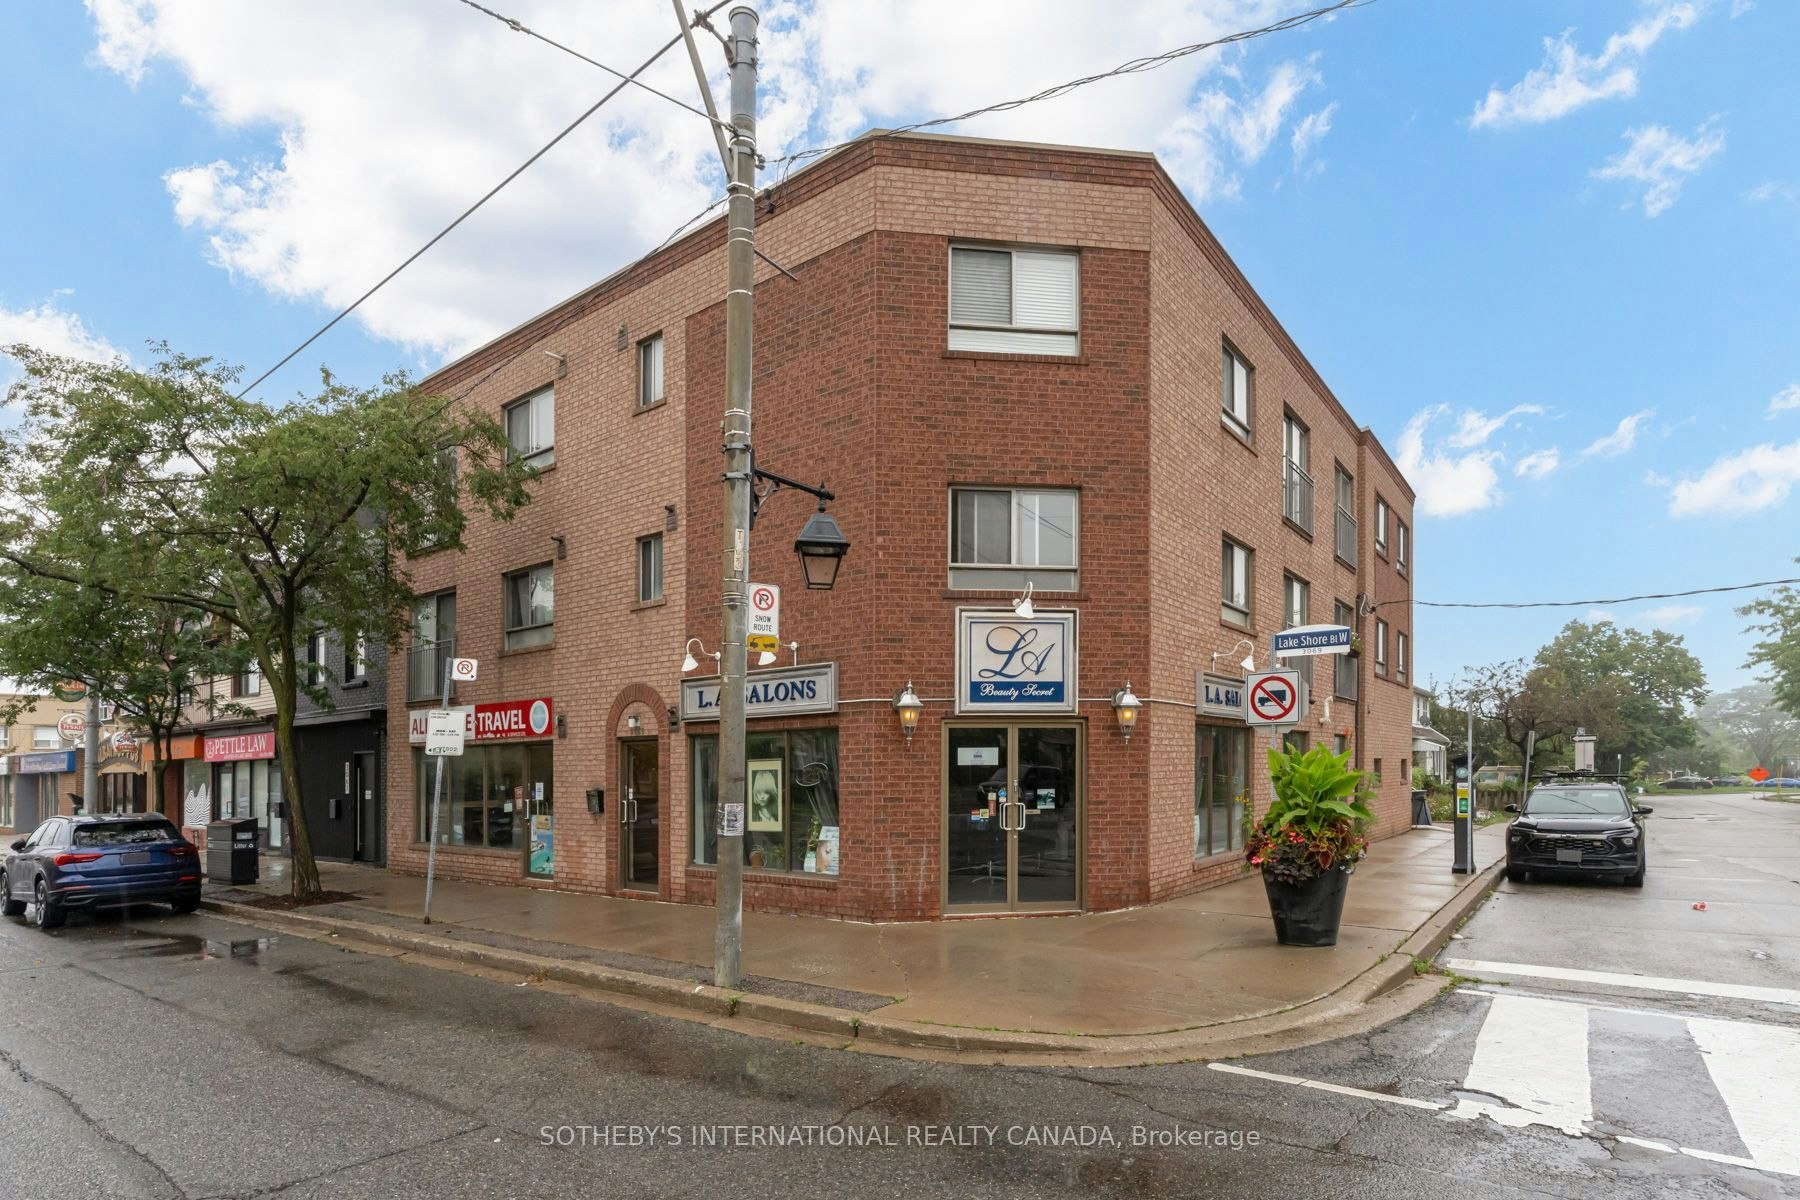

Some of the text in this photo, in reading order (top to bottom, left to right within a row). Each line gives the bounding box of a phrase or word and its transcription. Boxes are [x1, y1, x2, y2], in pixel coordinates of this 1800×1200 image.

[753, 624, 773, 632] ROUTE
[755, 615, 772, 623] SNOW
[1278, 637, 1299, 648] Lake
[1301, 635, 1328, 646] Shore
[1339, 632, 1348, 643] W
[745, 679, 817, 704] ALONS
[980, 683, 1055, 701] Beauty Secret
[477, 709, 527, 732] TRAVEL
[214, 735, 267, 755] PETTLE LAW
